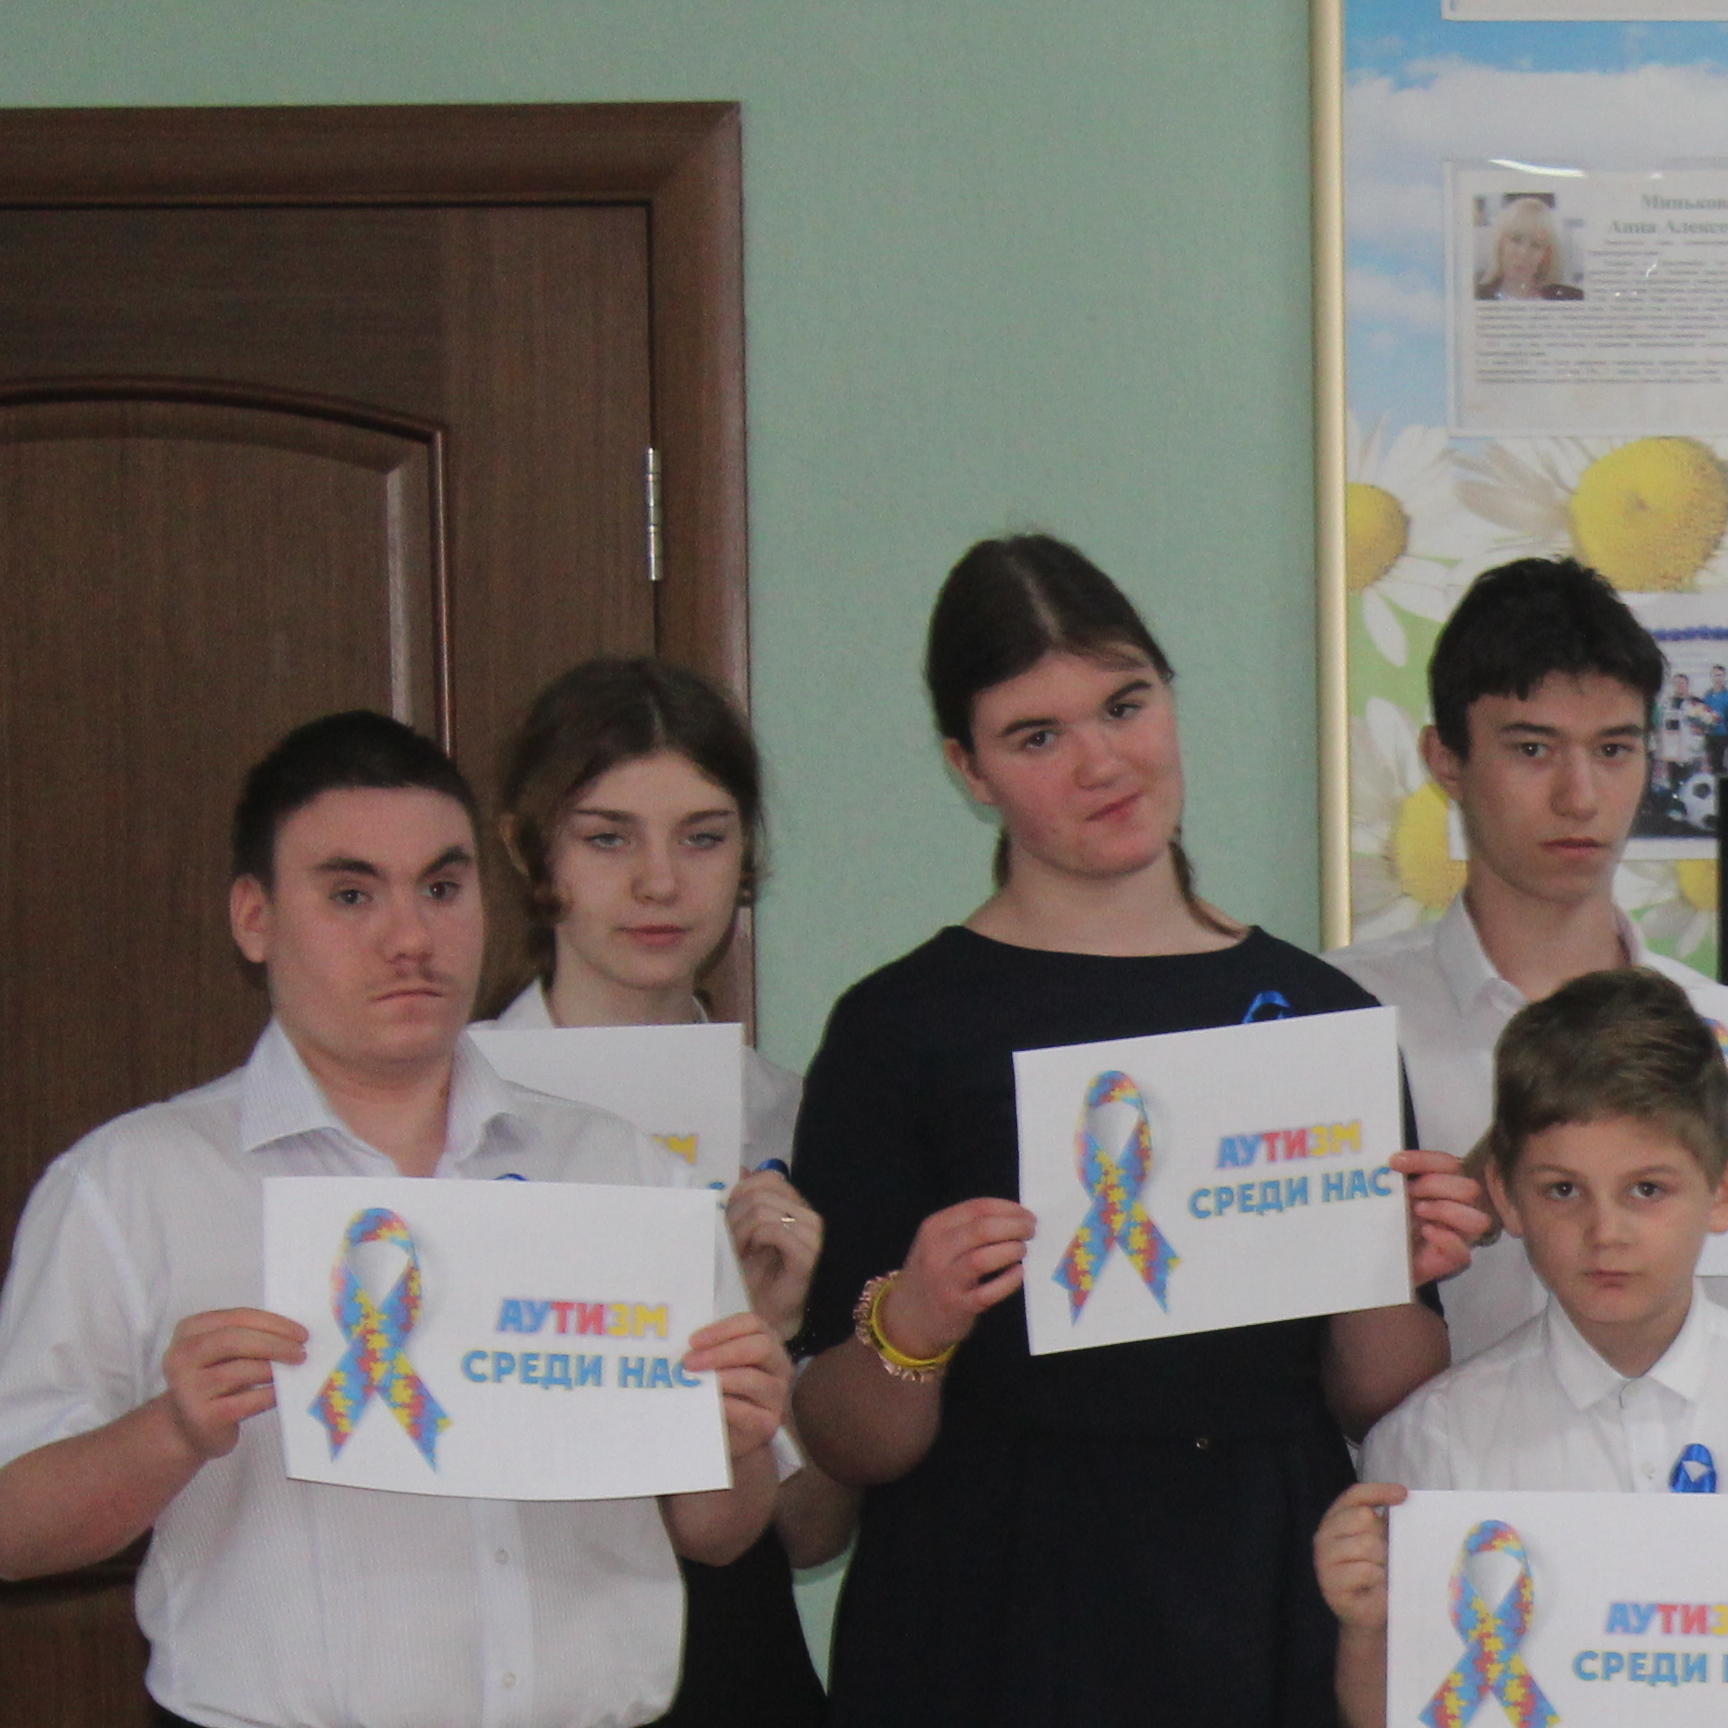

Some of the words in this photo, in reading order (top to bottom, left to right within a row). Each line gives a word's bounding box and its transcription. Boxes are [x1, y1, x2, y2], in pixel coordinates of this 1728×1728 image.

[1218, 1121, 1361, 1168] АУТИЗМ
[1190, 1177, 1309, 1219] СРЕДИ
[1323, 1166, 1393, 1203] НАС
[497, 1299, 668, 1338] АУТИЗМ
[463, 1351, 603, 1389] СРЕДИ
[1574, 1651, 1708, 1686] СРЕДИ
